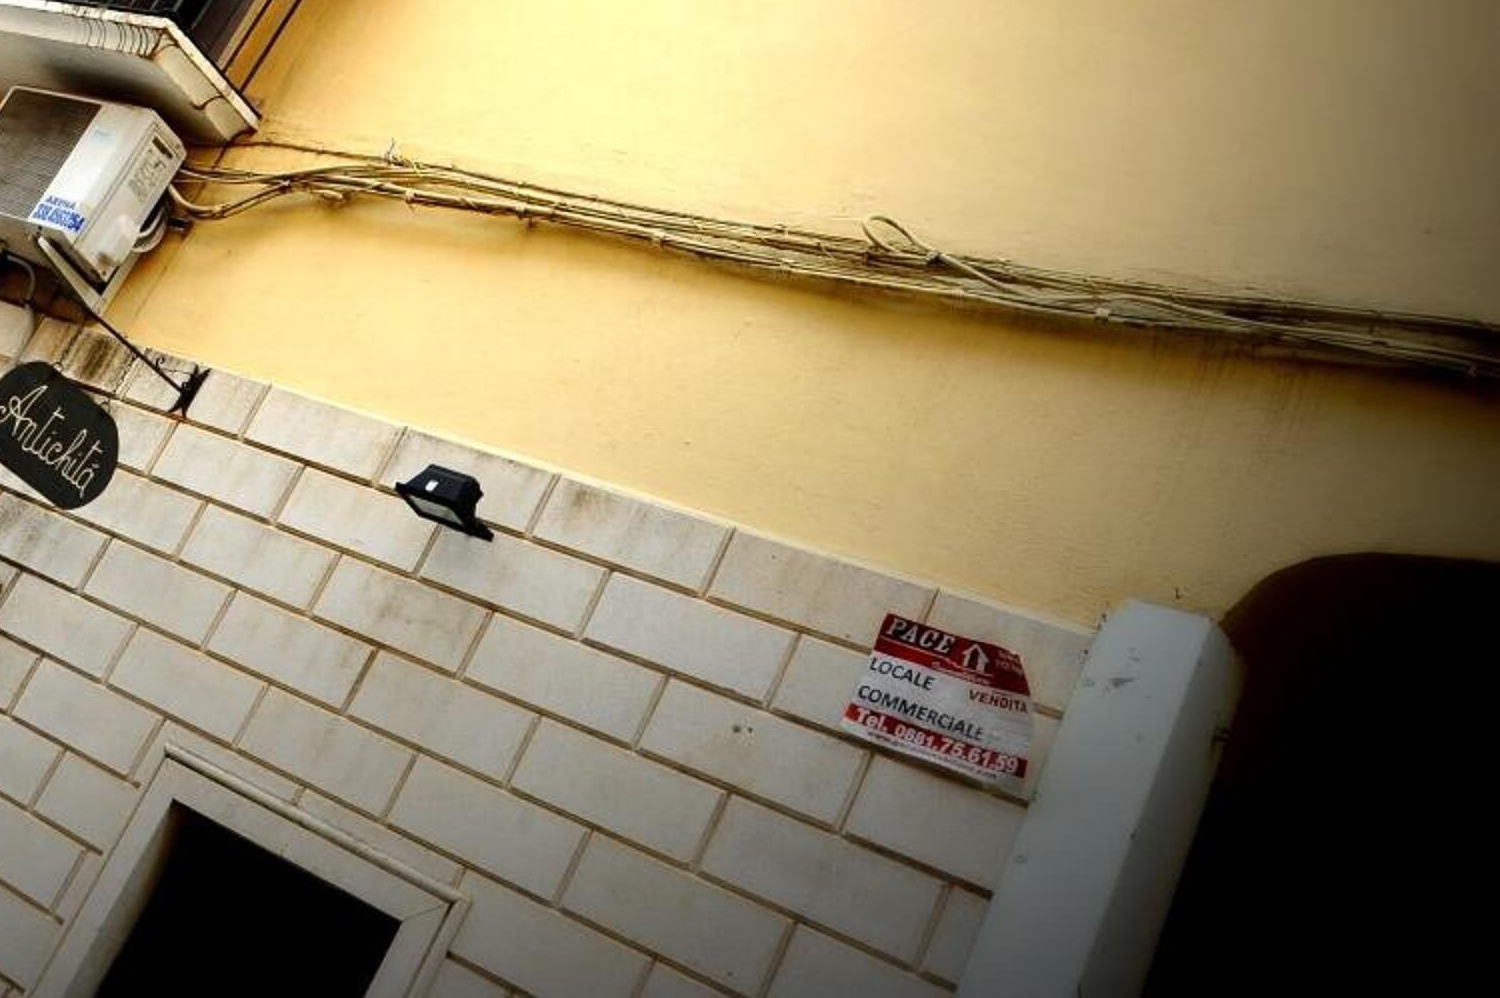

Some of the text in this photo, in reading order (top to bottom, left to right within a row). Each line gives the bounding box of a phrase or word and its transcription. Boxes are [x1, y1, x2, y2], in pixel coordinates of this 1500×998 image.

[886, 616, 957, 655] PACE
[869, 656, 937, 692] LOCALE
[856, 706, 889, 733] Tel.
[857, 684, 987, 742] COMMERCIALE
[968, 688, 1029, 715] VENDITA
